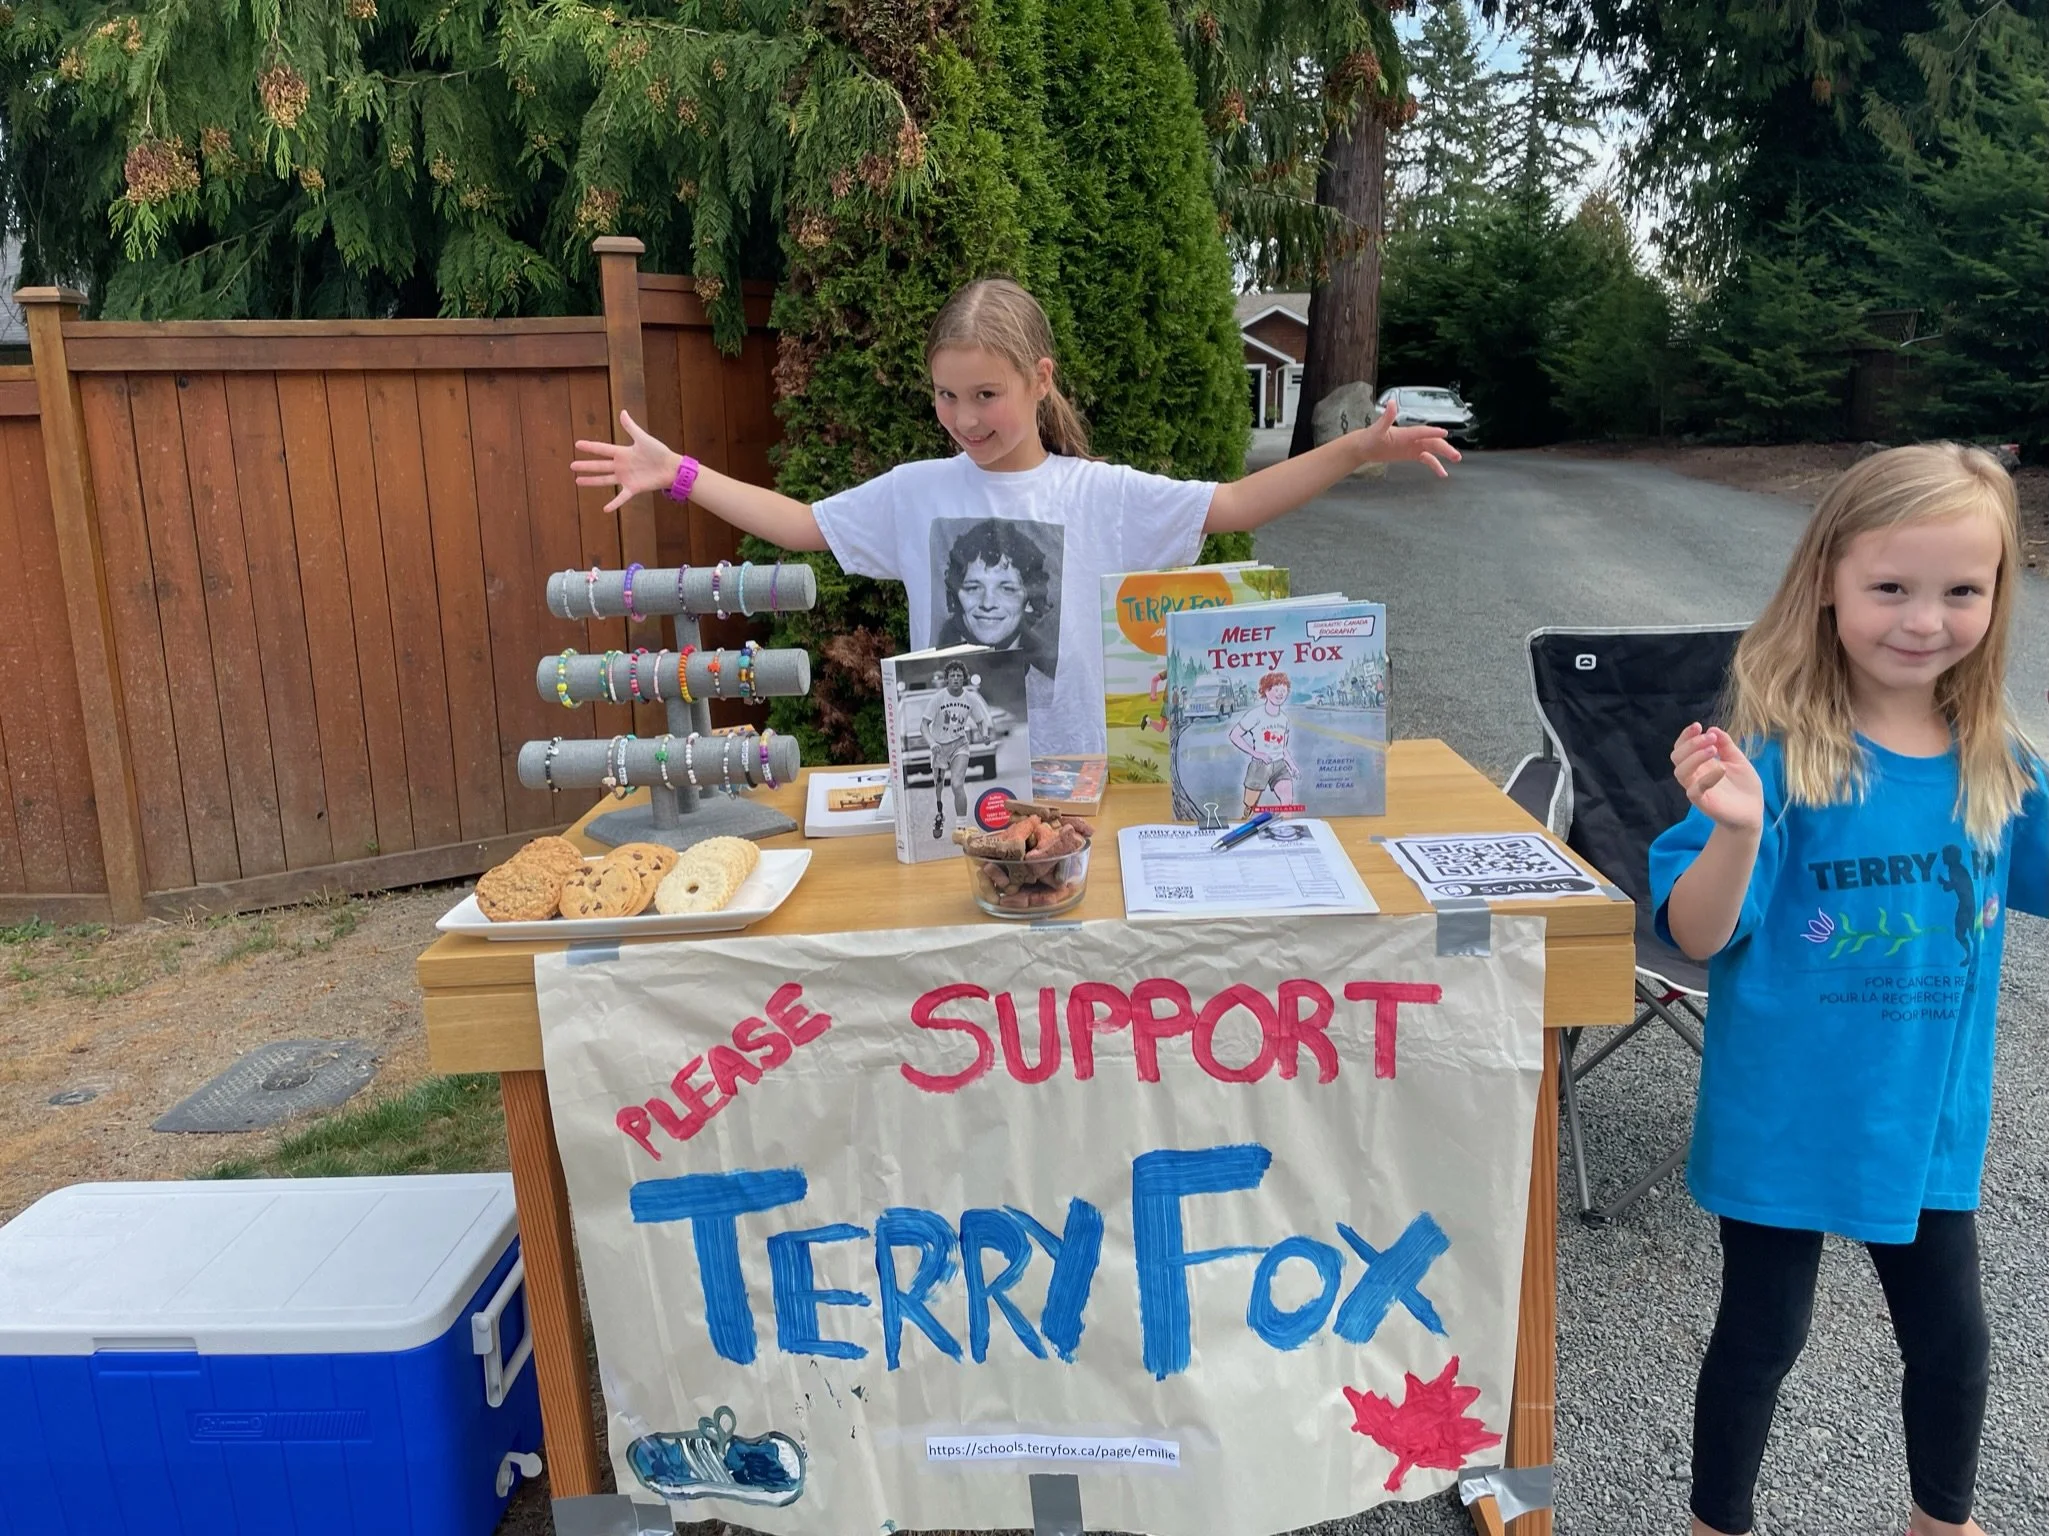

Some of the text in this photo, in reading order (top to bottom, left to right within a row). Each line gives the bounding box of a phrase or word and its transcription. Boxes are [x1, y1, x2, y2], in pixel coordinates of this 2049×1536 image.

[1121, 595, 1185, 624] TERRY
[1221, 625, 1276, 645] MEET
[1207, 641, 1343, 671] Terry Fox
[1808, 852, 1938, 891] TERRY
[1479, 882, 1575, 894] SCAN ME
[1864, 976, 1893, 989] FOR
[1896, 975, 1951, 989] CANCER
[1819, 992, 1859, 1005] POUR
[1861, 992, 1879, 1003] LA
[616, 979, 1442, 1159] PLEASE SUPPORT
[630, 1143, 1451, 1382] TERRY FOX
[928, 1441, 1177, 1461] https://schools.terryfox.ca/page/emilie
